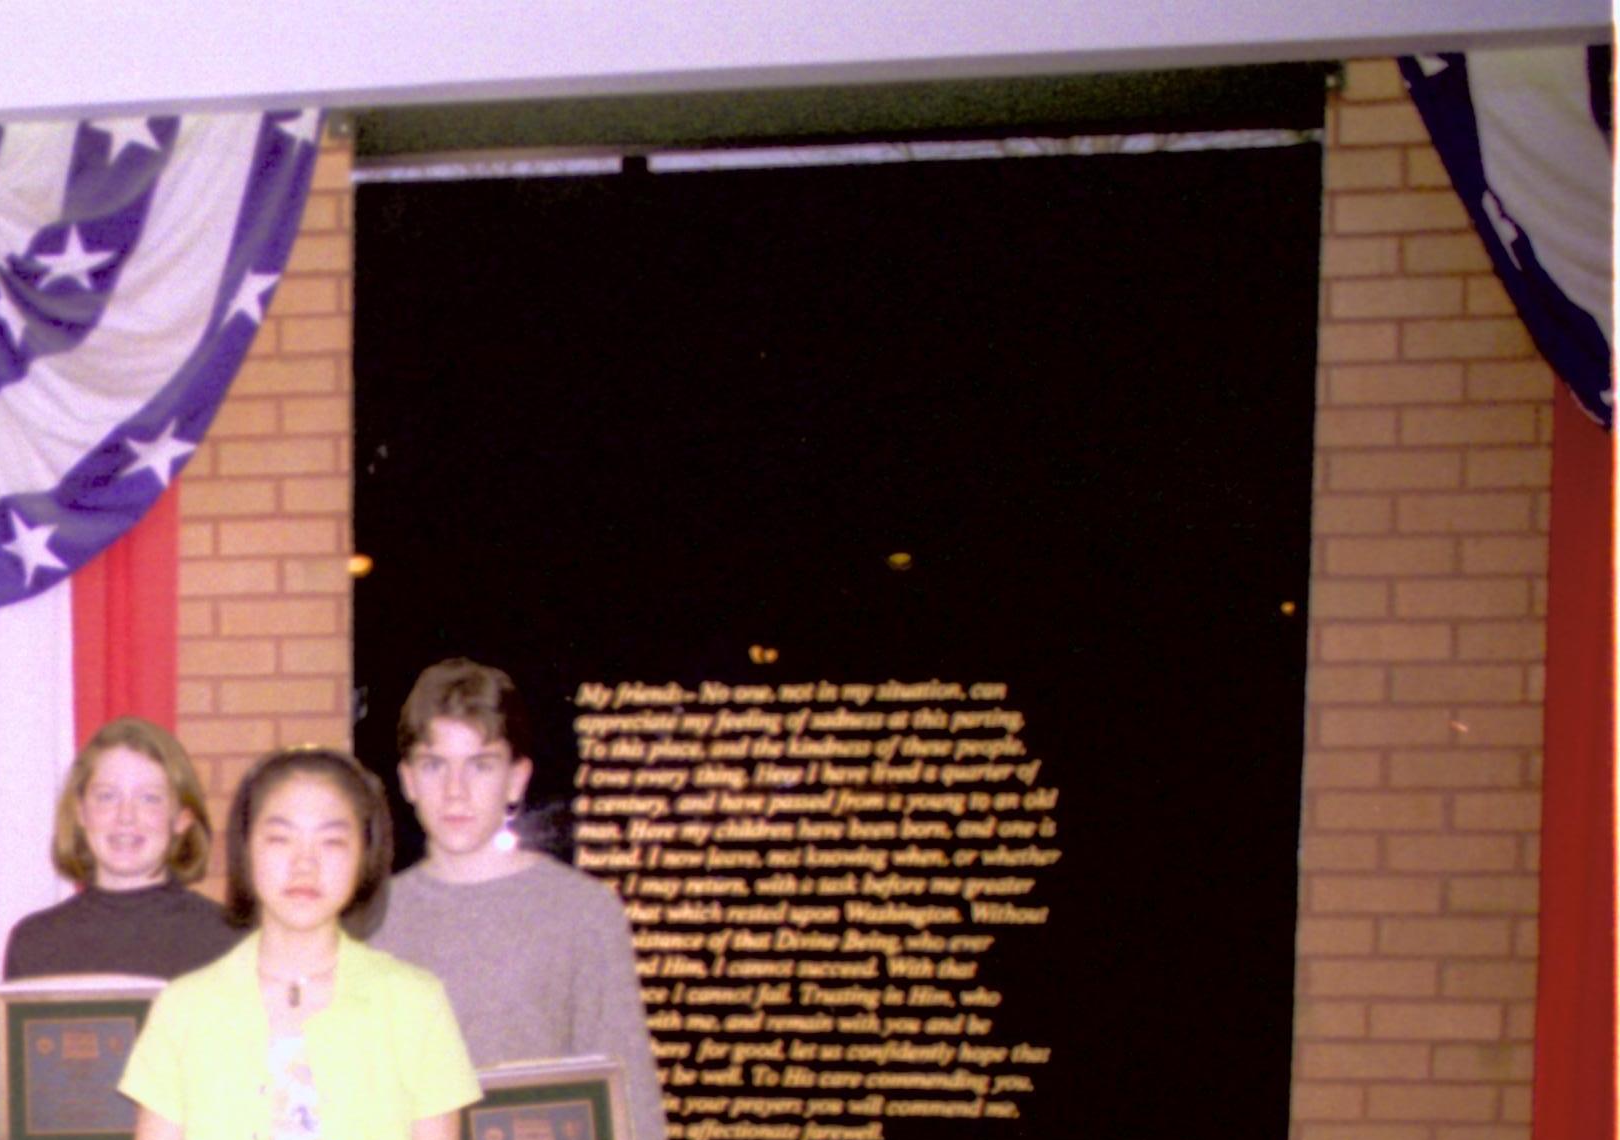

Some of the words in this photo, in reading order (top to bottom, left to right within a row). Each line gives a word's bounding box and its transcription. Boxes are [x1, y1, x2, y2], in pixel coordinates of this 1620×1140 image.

[576, 682, 613, 705] My
[699, 681, 730, 701] No
[778, 682, 816, 701] not
[816, 680, 838, 700] in
[840, 683, 875, 704] my
[969, 682, 1007, 699] can
[680, 713, 714, 735] my
[784, 707, 812, 734] of
[886, 710, 911, 729] at
[578, 736, 607, 759] To
[708, 735, 751, 758] and
[751, 735, 785, 758] the
[873, 734, 902, 761] of
[574, 765, 591, 787] I
[589, 768, 631, 787] owe
[805, 762, 820, 784] I
[922, 764, 940, 782] a
[1015, 759, 1042, 784] of
[572, 795, 590, 815] a
[676, 791, 717, 814] and
[887, 793, 904, 811] a
[968, 791, 992, 811] to
[993, 792, 1021, 810] an
[1022, 787, 1059, 810] old
[679, 821, 714, 844] my
[955, 815, 998, 838] and
[996, 820, 1038, 837] one
[1039, 817, 1057, 836] is
[646, 846, 662, 869] I
[660, 849, 705, 868] now
[764, 847, 805, 867] not
[952, 849, 980, 866] or
[623, 872, 639, 895] I
[637, 876, 681, 900] may
[799, 877, 816, 894] a
[929, 877, 963, 894] me
[706, 928, 734, 955] of
[904, 930, 948, 952] who
[711, 955, 726, 977] I
[671, 982, 686, 1003] I
[882, 985, 906, 1005] in
[959, 986, 1002, 1006] who
[722, 1009, 766, 1032] and
[881, 1017, 922, 1036] you
[923, 1013, 967, 1034] and
[966, 1014, 993, 1034] be
[695, 1037, 731, 1062] for
[788, 1039, 819, 1060] let
[818, 1044, 844, 1060] us
[670, 1063, 698, 1085] be
[751, 1065, 781, 1086] To
[781, 1065, 817, 1087] His
[802, 1098, 845, 1117] you
